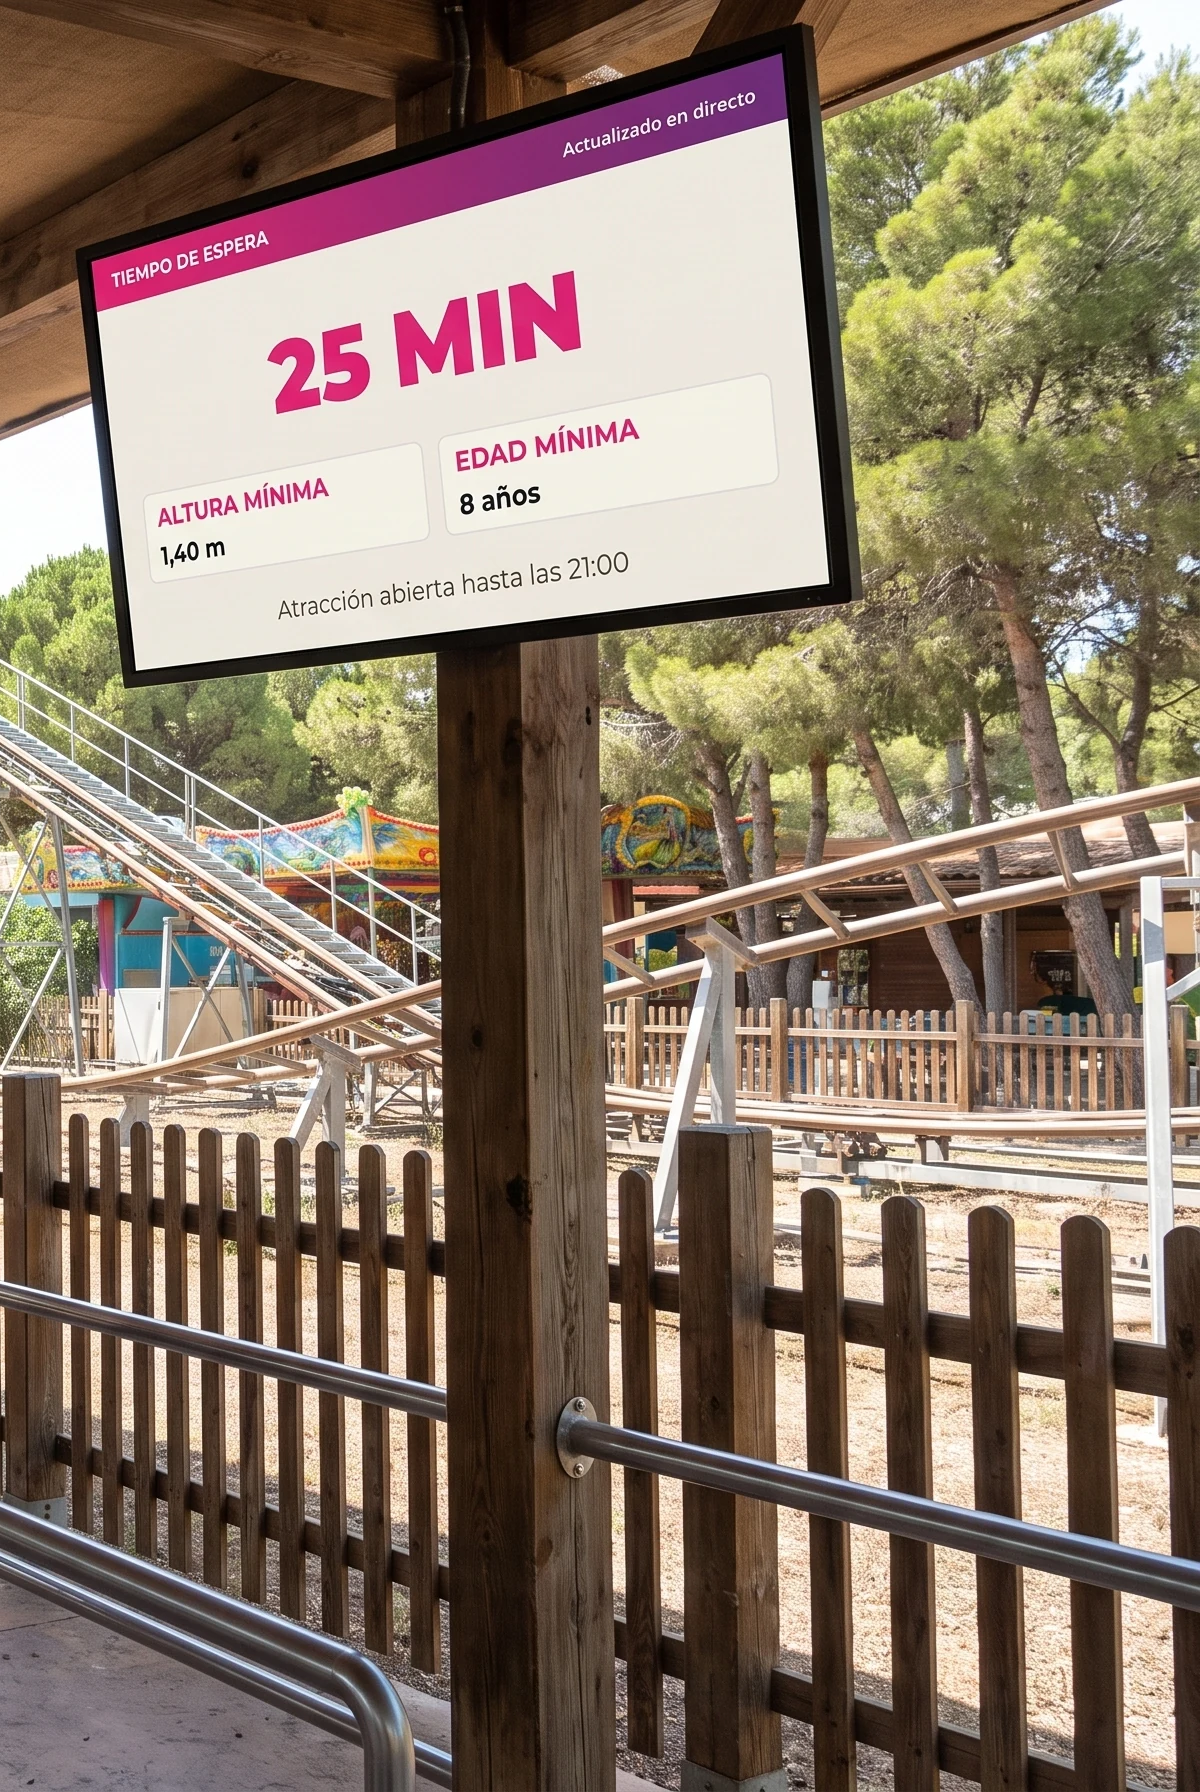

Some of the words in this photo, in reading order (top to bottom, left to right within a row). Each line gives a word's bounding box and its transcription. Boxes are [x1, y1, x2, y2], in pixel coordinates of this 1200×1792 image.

[561, 116, 663, 159] Actualizado
[666, 111, 688, 128] en
[692, 90, 757, 121] directo
[110, 257, 174, 289] TIEMPO
[176, 249, 200, 270] DE
[203, 229, 270, 263] ESPERA
[265, 322, 371, 416] 25
[393, 269, 583, 389] MIN
[454, 439, 528, 473] EDAD
[534, 417, 641, 459] MÍNIMA
[156, 493, 241, 529] ALTURA
[243, 477, 331, 512] MÍNIMA
[458, 492, 476, 517] 8
[480, 482, 542, 514] años
[159, 540, 201, 569] 1,40
[204, 539, 227, 560] m
[276, 587, 374, 621] Atracción
[378, 578, 456, 607] abierta
[460, 570, 524, 596] hasta
[529, 562, 563, 587] las
[566, 550, 630, 581] 21:00
